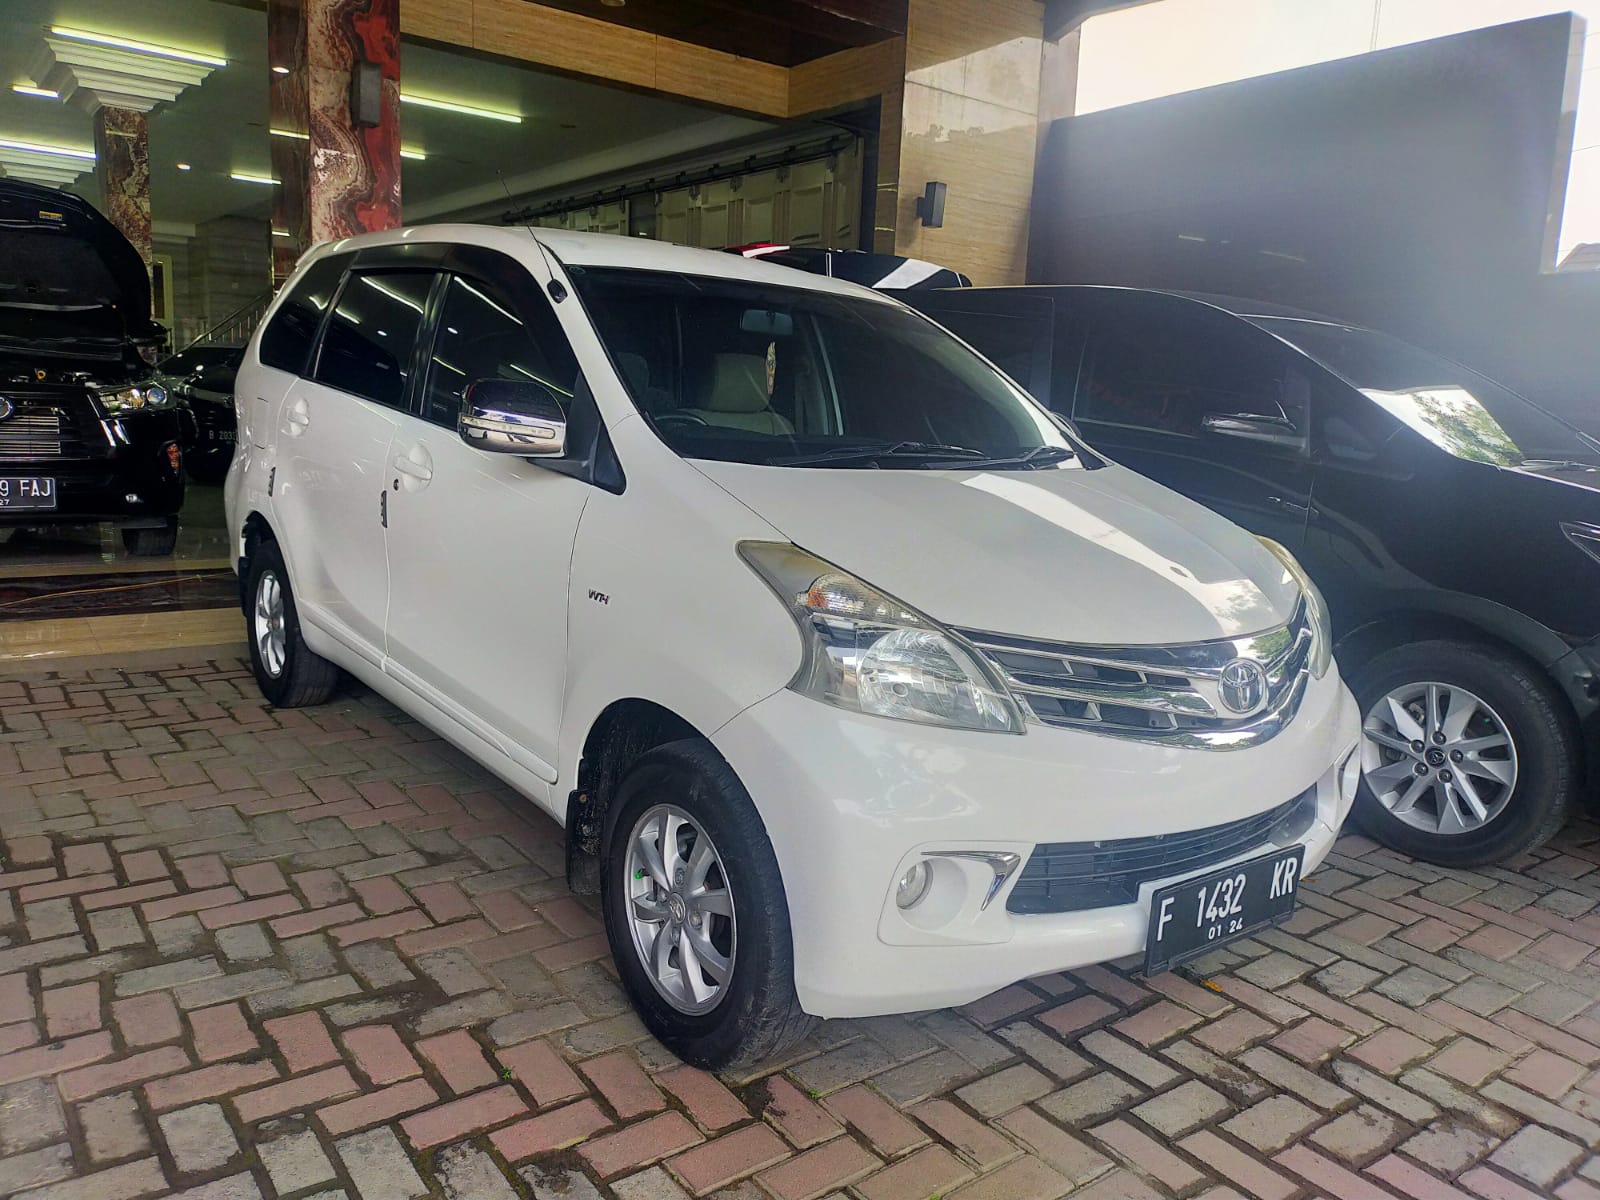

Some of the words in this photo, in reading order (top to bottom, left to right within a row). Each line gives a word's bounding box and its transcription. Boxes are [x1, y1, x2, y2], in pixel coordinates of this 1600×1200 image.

[19, 479, 51, 497] FAJ
[1157, 897, 1175, 941] F
[1196, 873, 1247, 928] 1432
[1269, 857, 1298, 900] KR
[1208, 924, 1222, 939] 01
[1228, 917, 1243, 933] 24
